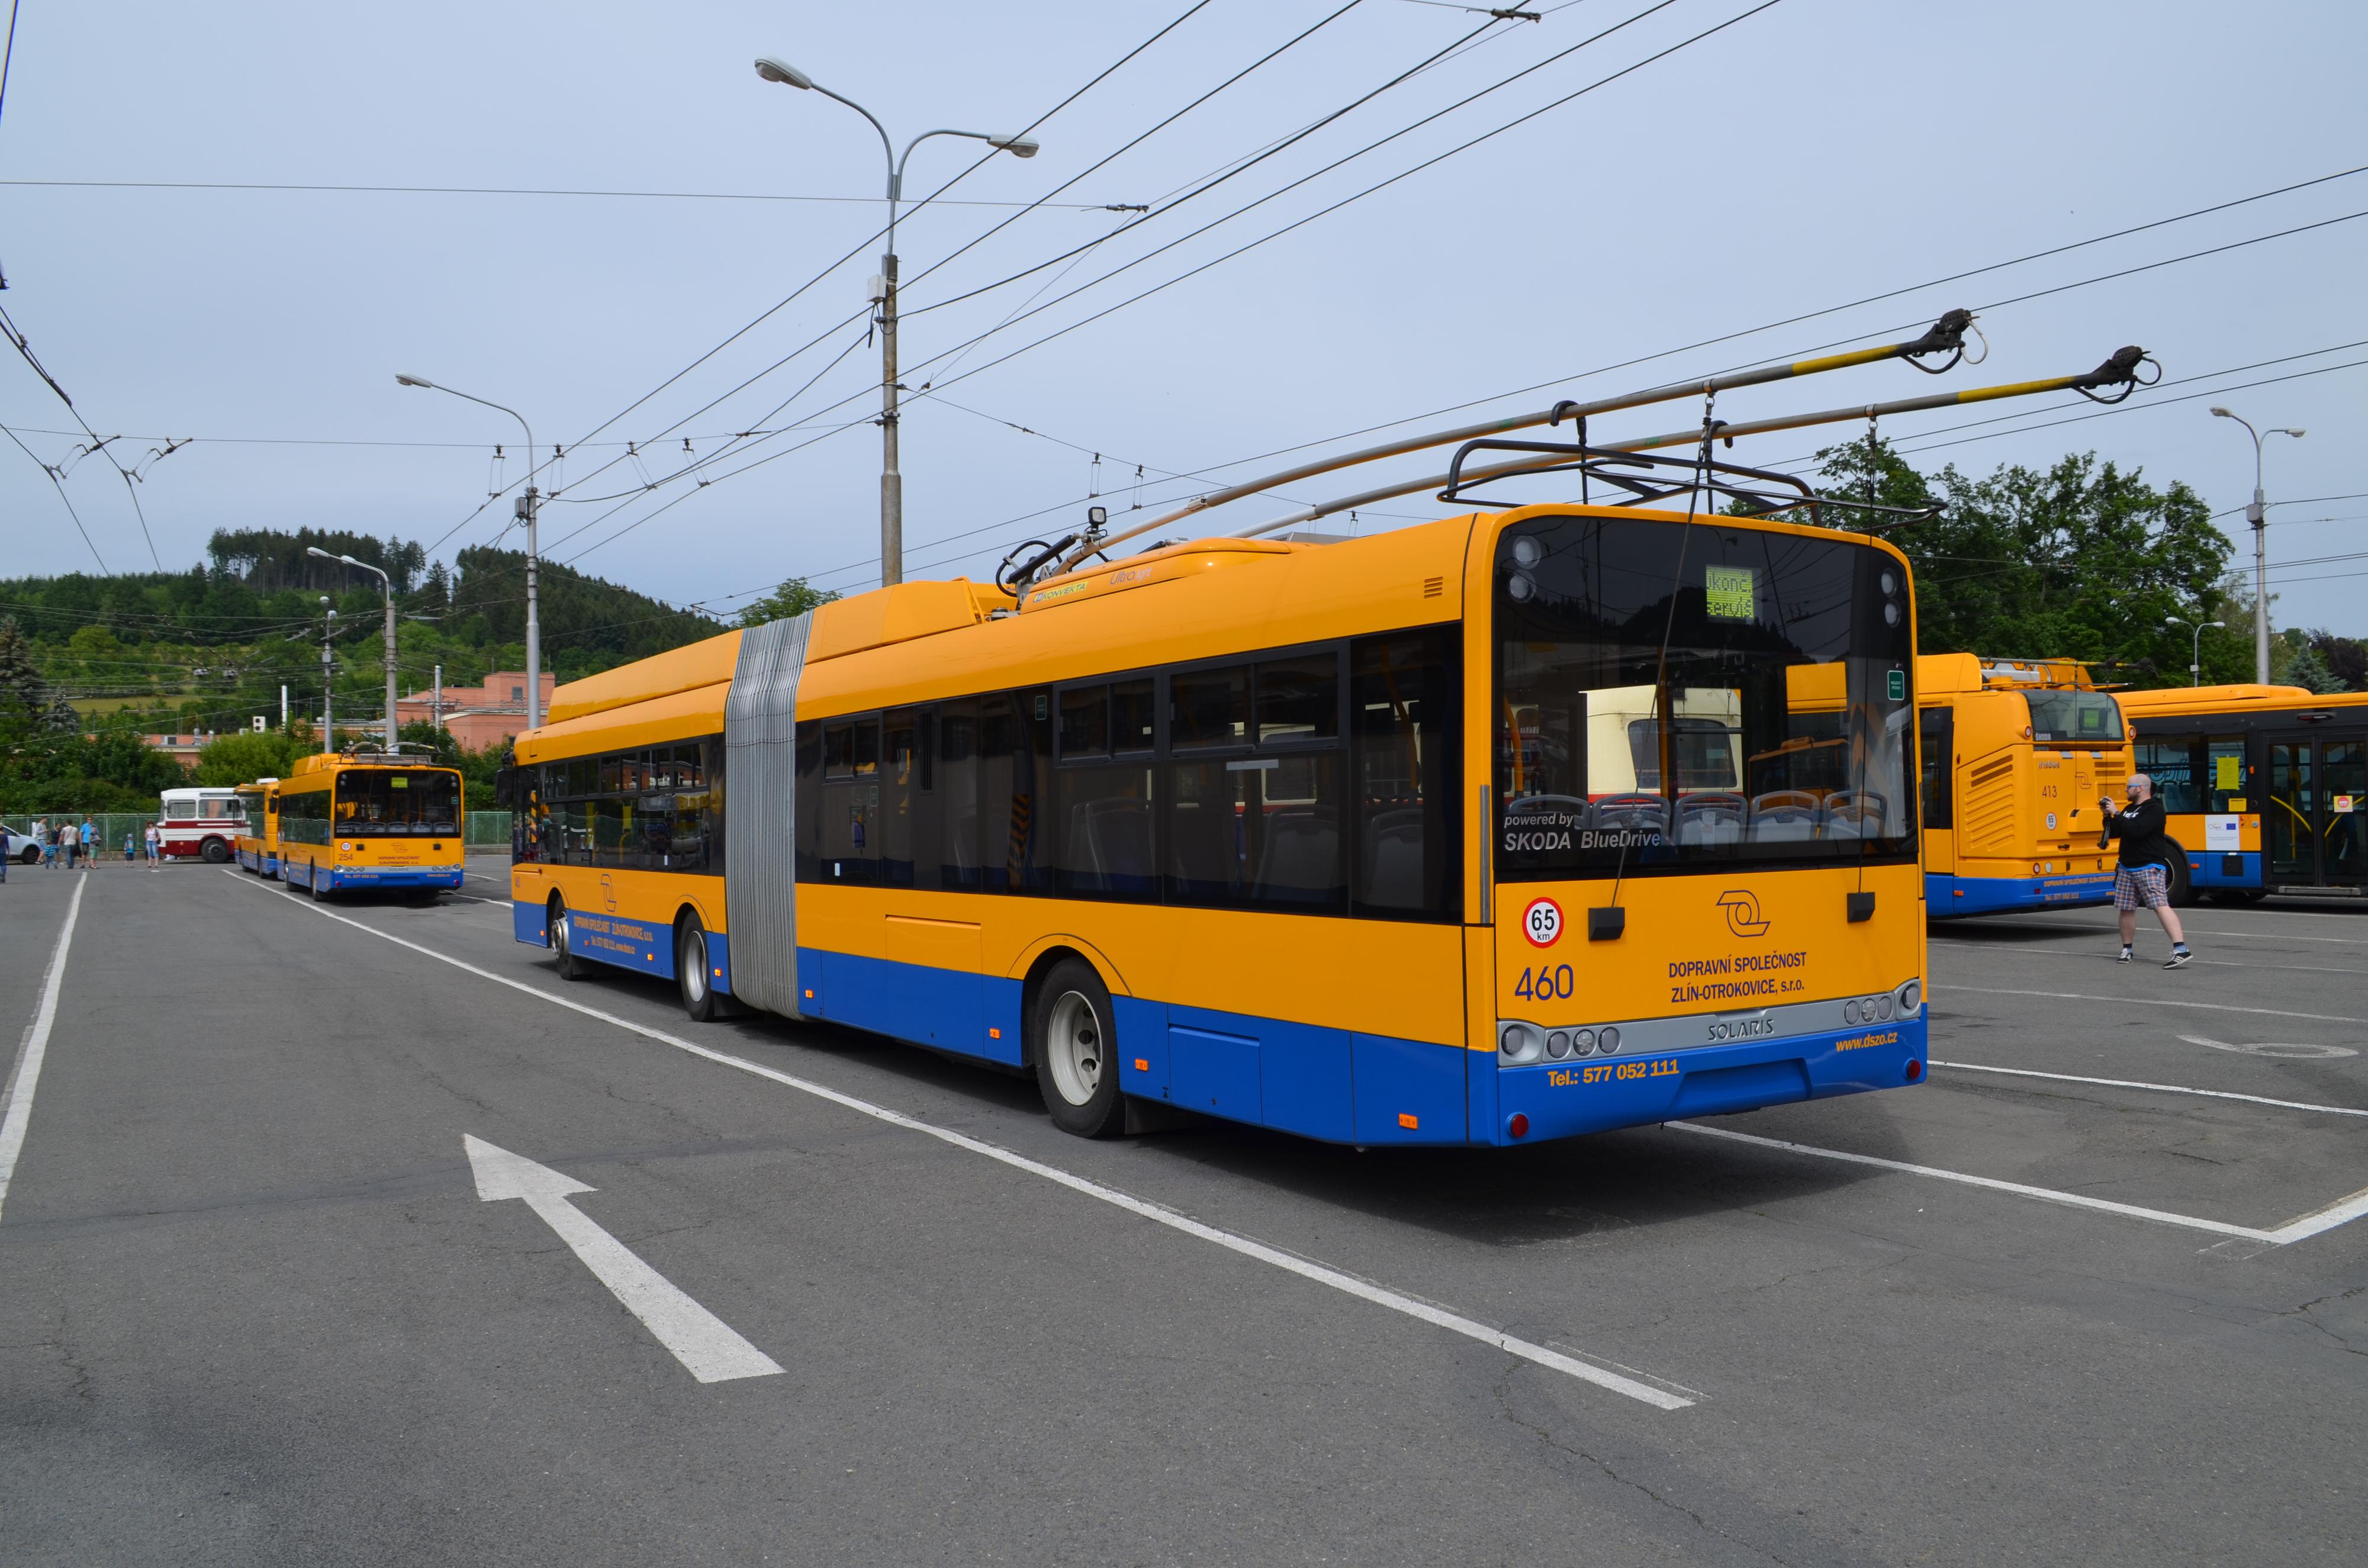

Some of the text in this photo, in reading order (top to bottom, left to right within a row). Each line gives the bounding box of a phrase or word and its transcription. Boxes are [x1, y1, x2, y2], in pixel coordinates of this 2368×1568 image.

[1041, 584, 1086, 600] KONVEKTA
[2042, 785, 2057, 797] 413
[1504, 813, 1574, 828] powered by
[2048, 815, 2054, 823] 65
[1504, 830, 1661, 851] SKODA BlueDrive
[1532, 909, 1555, 931] 65
[1537, 932, 1550, 941] km
[1669, 950, 1807, 978] DOPRAVNÍ SPOLEČNOST
[1515, 964, 1574, 1002] 460
[1671, 980, 1804, 1003] ZLÍN-OTROKOVICE, s.r.o.
[1709, 1019, 1774, 1041] SOLARIS
[1836, 1032, 1898, 1052] www.dszo.cz
[1547, 1059, 1680, 1087] Tel.: 577 052 111
